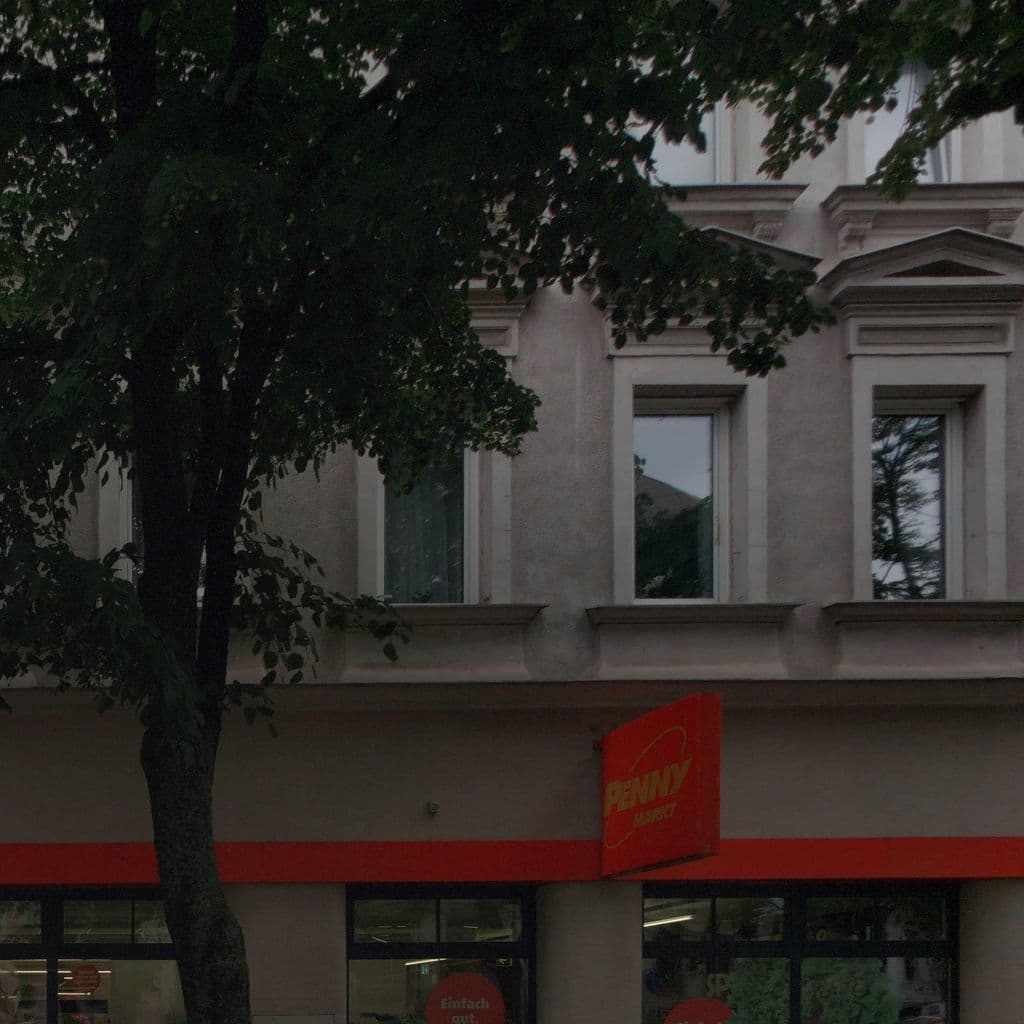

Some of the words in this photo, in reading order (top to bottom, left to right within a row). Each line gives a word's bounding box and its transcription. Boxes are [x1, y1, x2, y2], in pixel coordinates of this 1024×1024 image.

[603, 758, 693, 817] PENNY
[632, 801, 677, 829] MARKT
[440, 997, 490, 1010] Einfach
